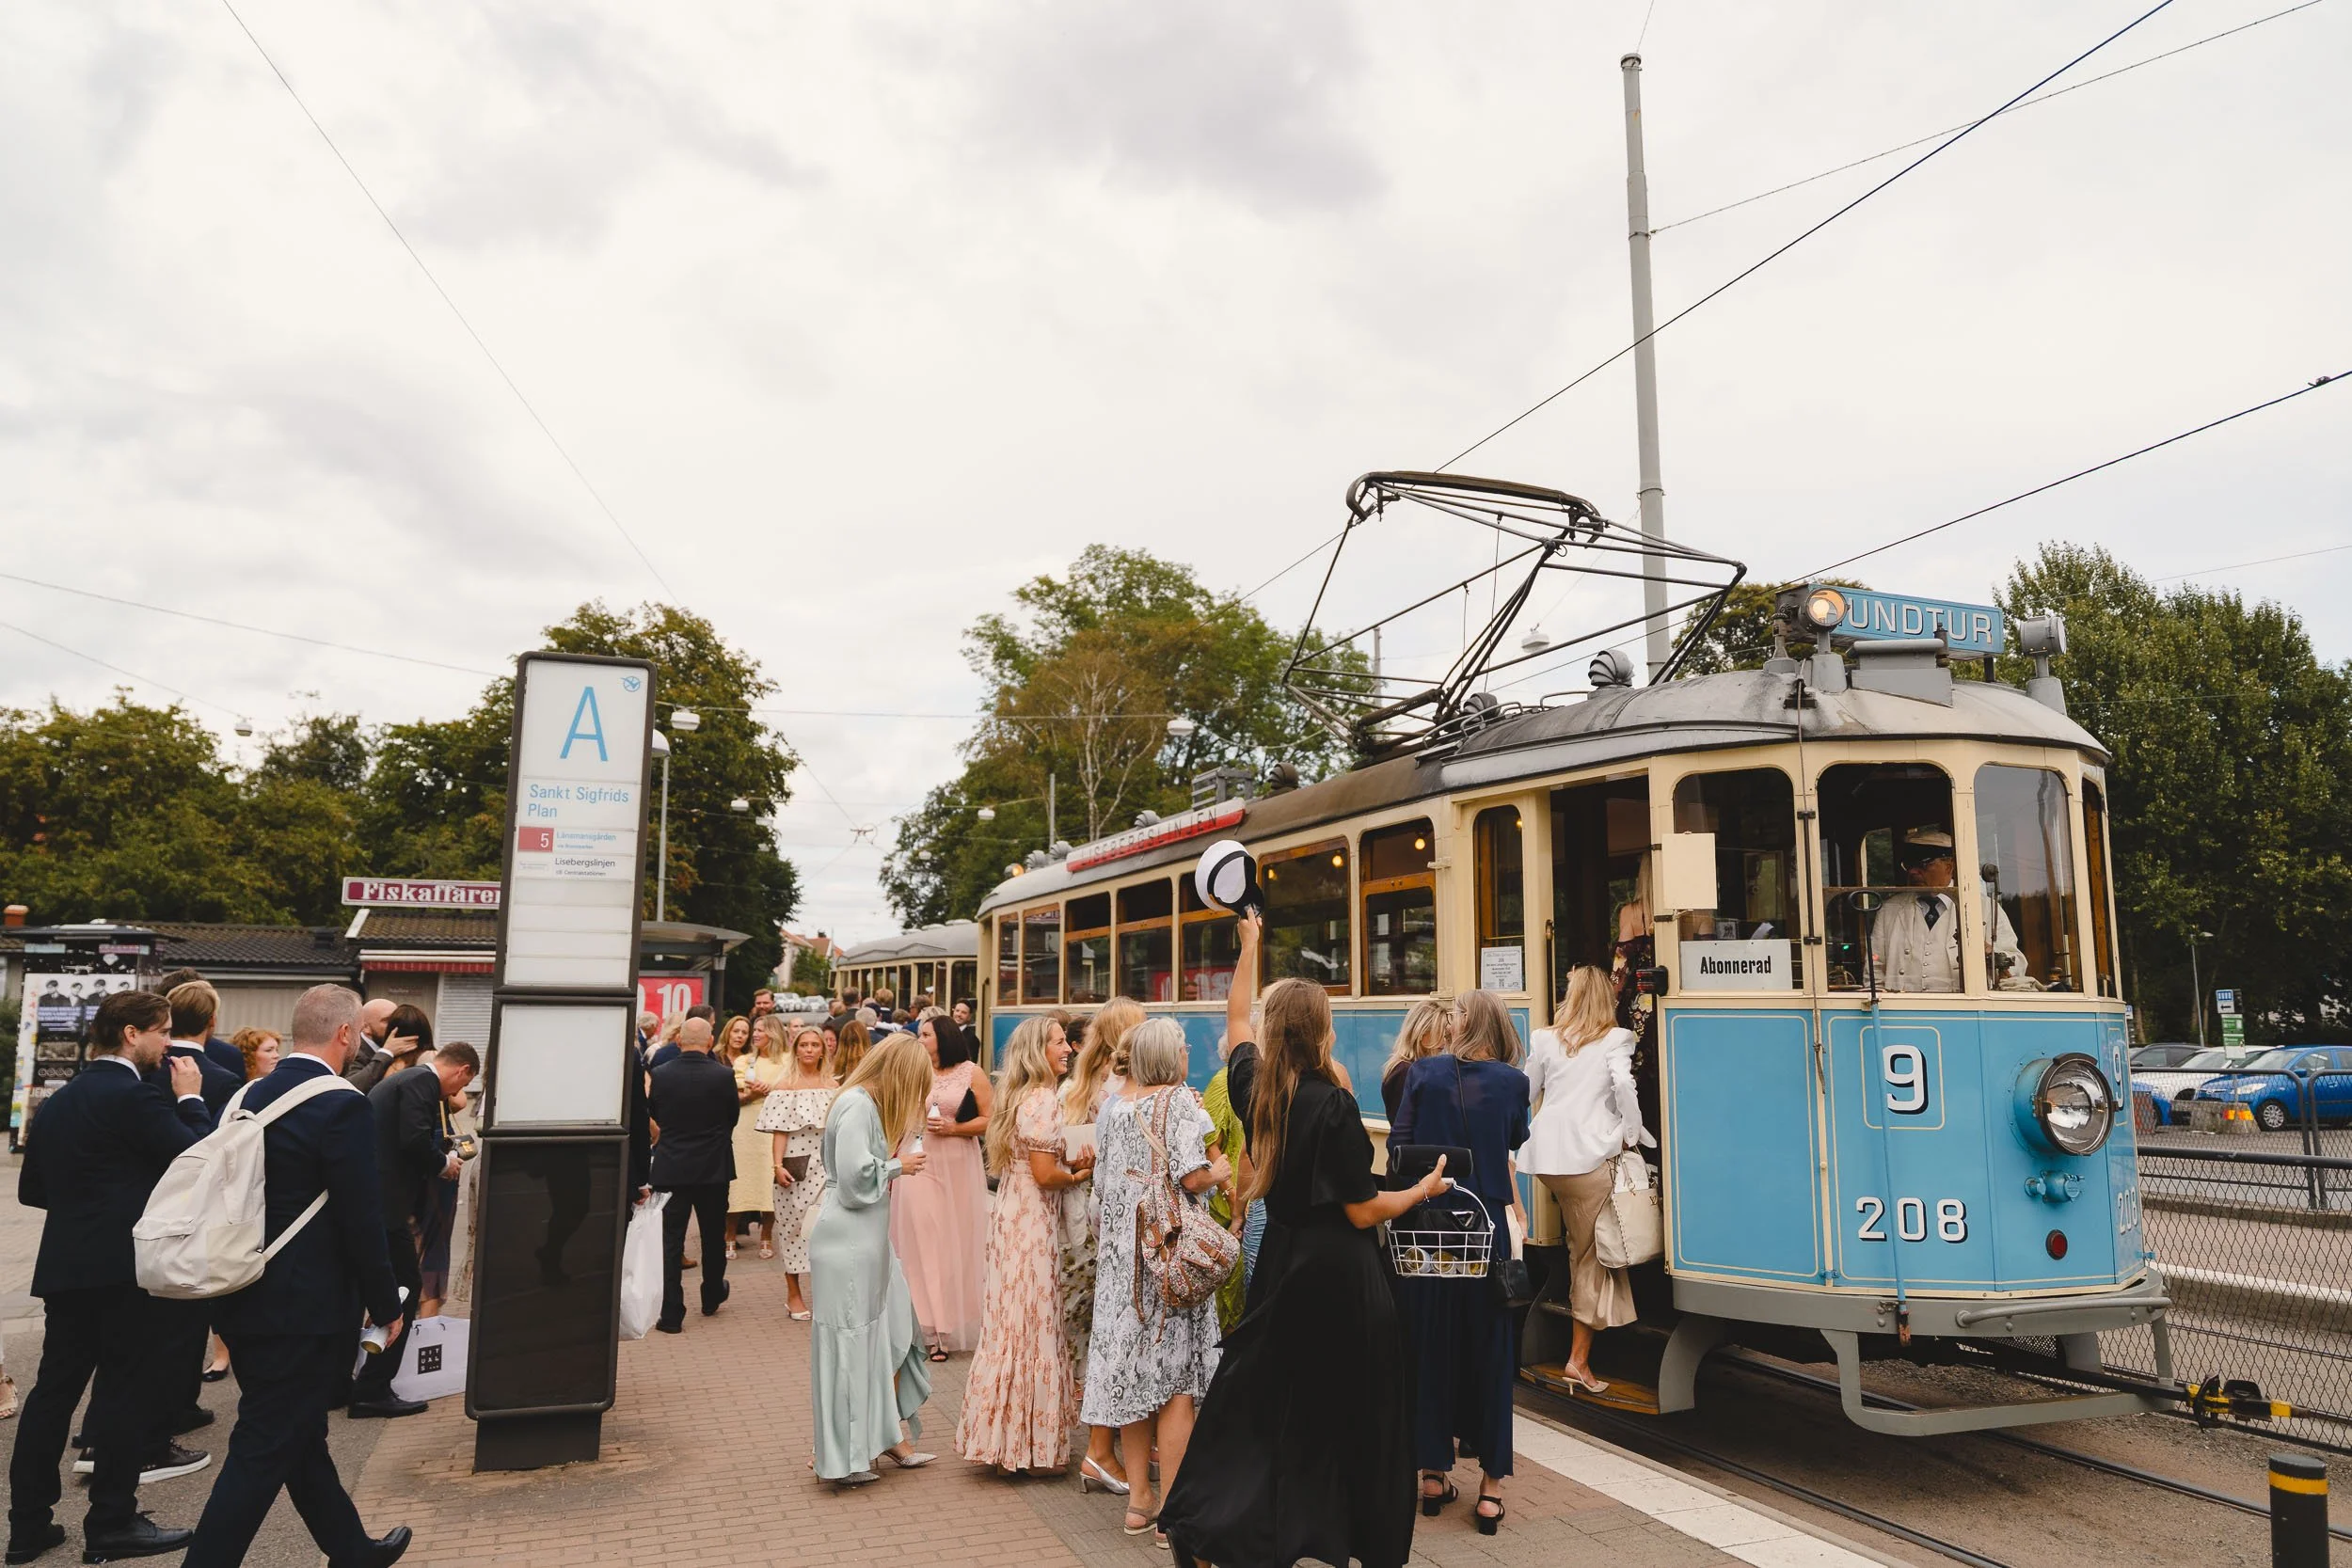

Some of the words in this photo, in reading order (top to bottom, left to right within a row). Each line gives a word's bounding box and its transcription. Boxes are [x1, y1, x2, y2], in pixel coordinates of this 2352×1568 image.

[1828, 598, 1992, 643] UNDTUR
[560, 687, 609, 762] A
[528, 803, 557, 817] Plan
[530, 784, 570, 800] Sankt
[576, 786, 629, 804] Sigfrids
[540, 832, 549, 848] 5
[555, 857, 615, 868] Lisebergslinjen
[1700, 956, 1772, 974] Abonnerad
[657, 983, 692, 1023] 10
[1882, 1044, 1929, 1115] 9
[2111, 1044, 2125, 1111] 9
[1855, 1196, 1968, 1243] 208
[2117, 1185, 2138, 1236] 208
